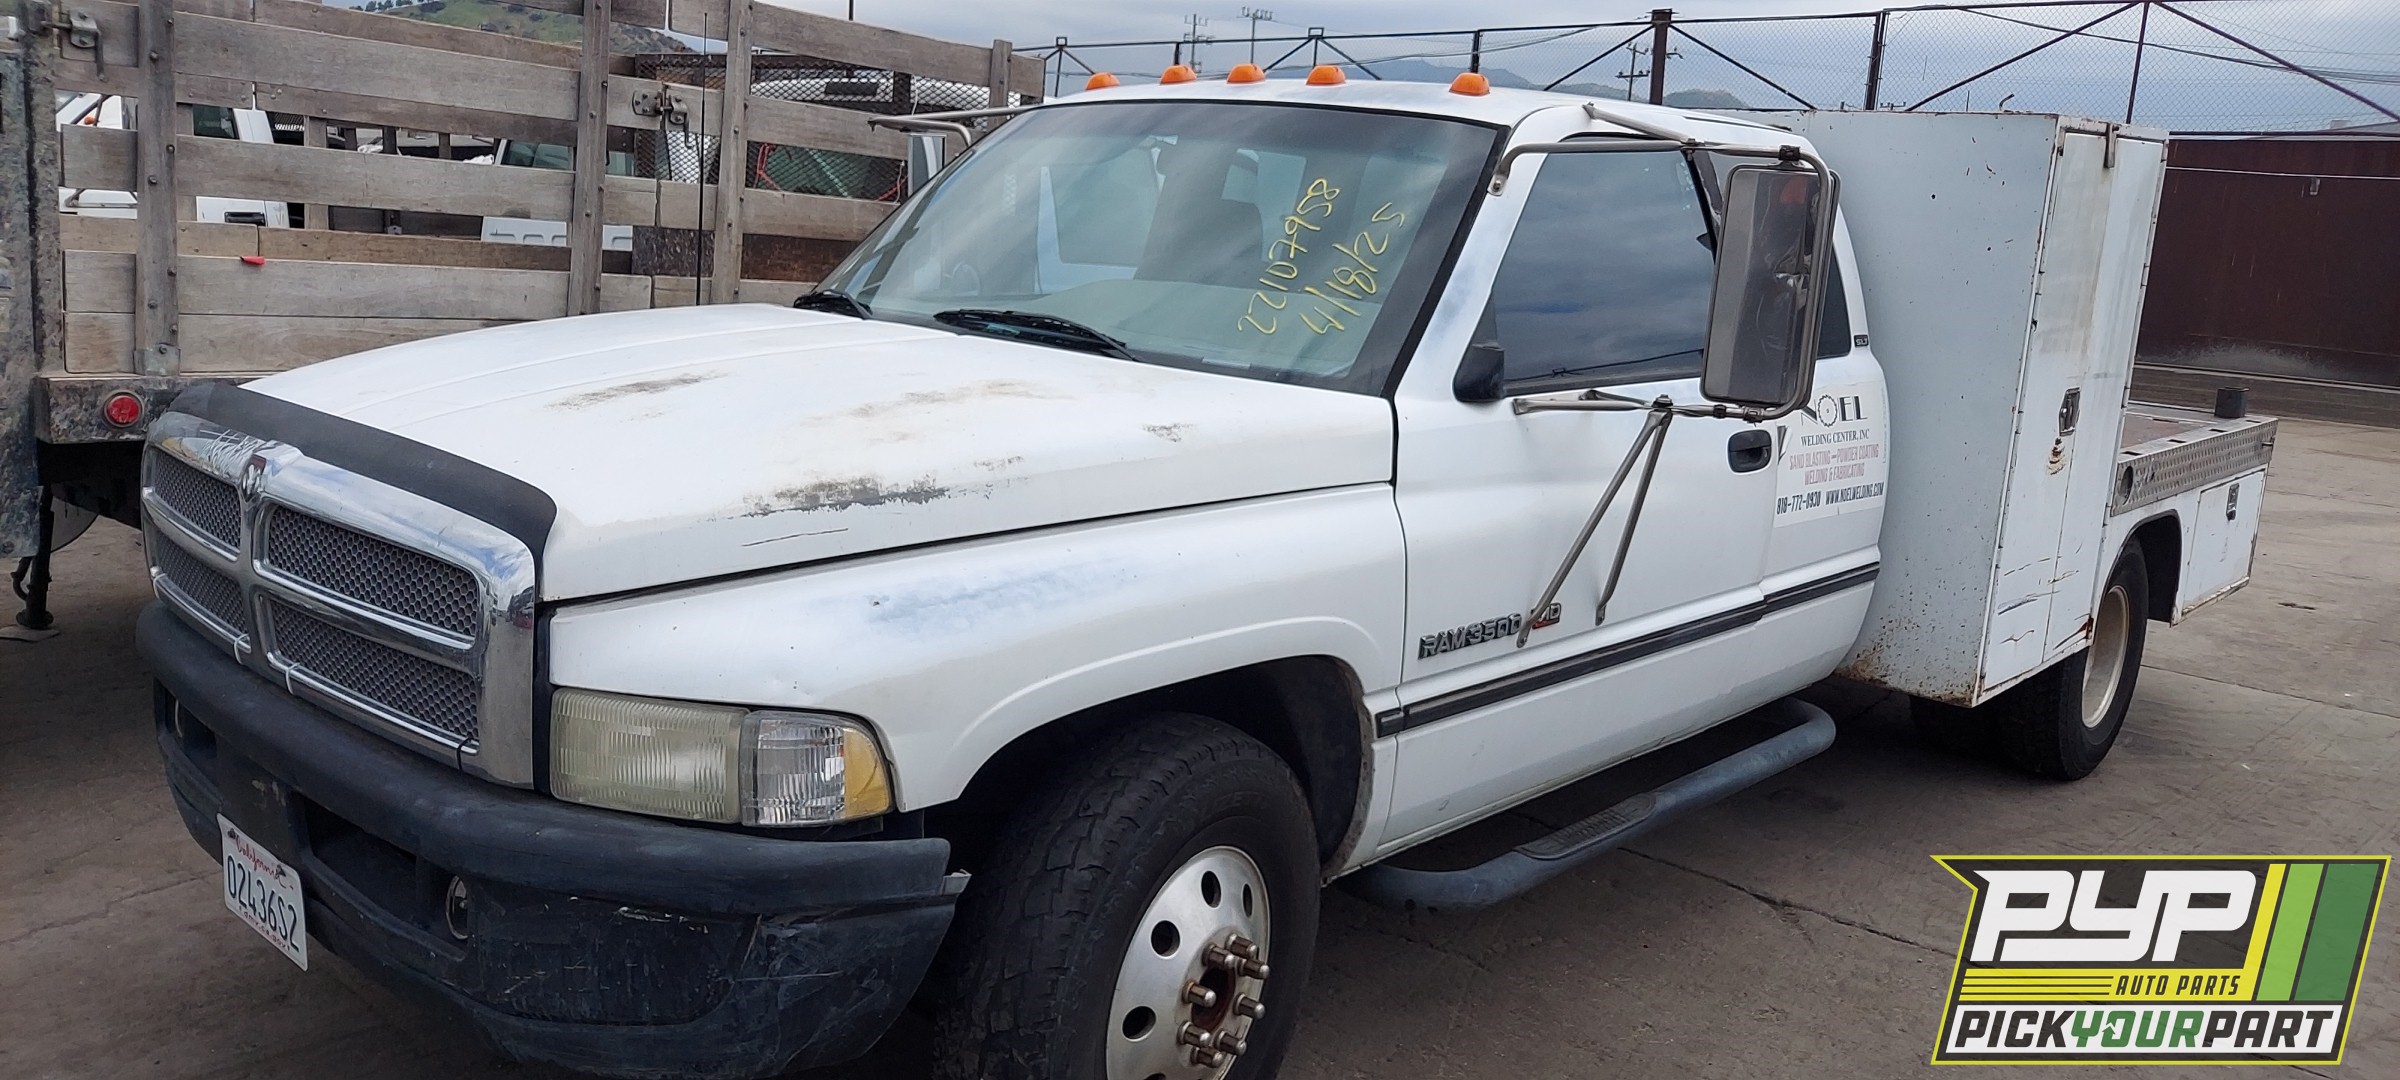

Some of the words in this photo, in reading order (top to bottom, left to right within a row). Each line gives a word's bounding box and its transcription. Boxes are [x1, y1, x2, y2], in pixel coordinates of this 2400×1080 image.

[1237, 178, 1341, 334] 22107958
[1299, 202, 1405, 334] 4/18/25
[1801, 394, 1868, 427] NOEL
[1790, 455, 1804, 470] SAND
[1805, 450, 1831, 467] BLASTING
[1859, 444, 1879, 460] COATING
[1801, 433, 1832, 446] WELDING
[1832, 430, 1859, 443] CENTER,
[1860, 429, 1870, 440] INC
[1805, 468, 1828, 485] WELDING
[1833, 462, 1865, 480] FABRICATING
[235, 834, 286, 888] California
[227, 855, 299, 952] 02436S2
